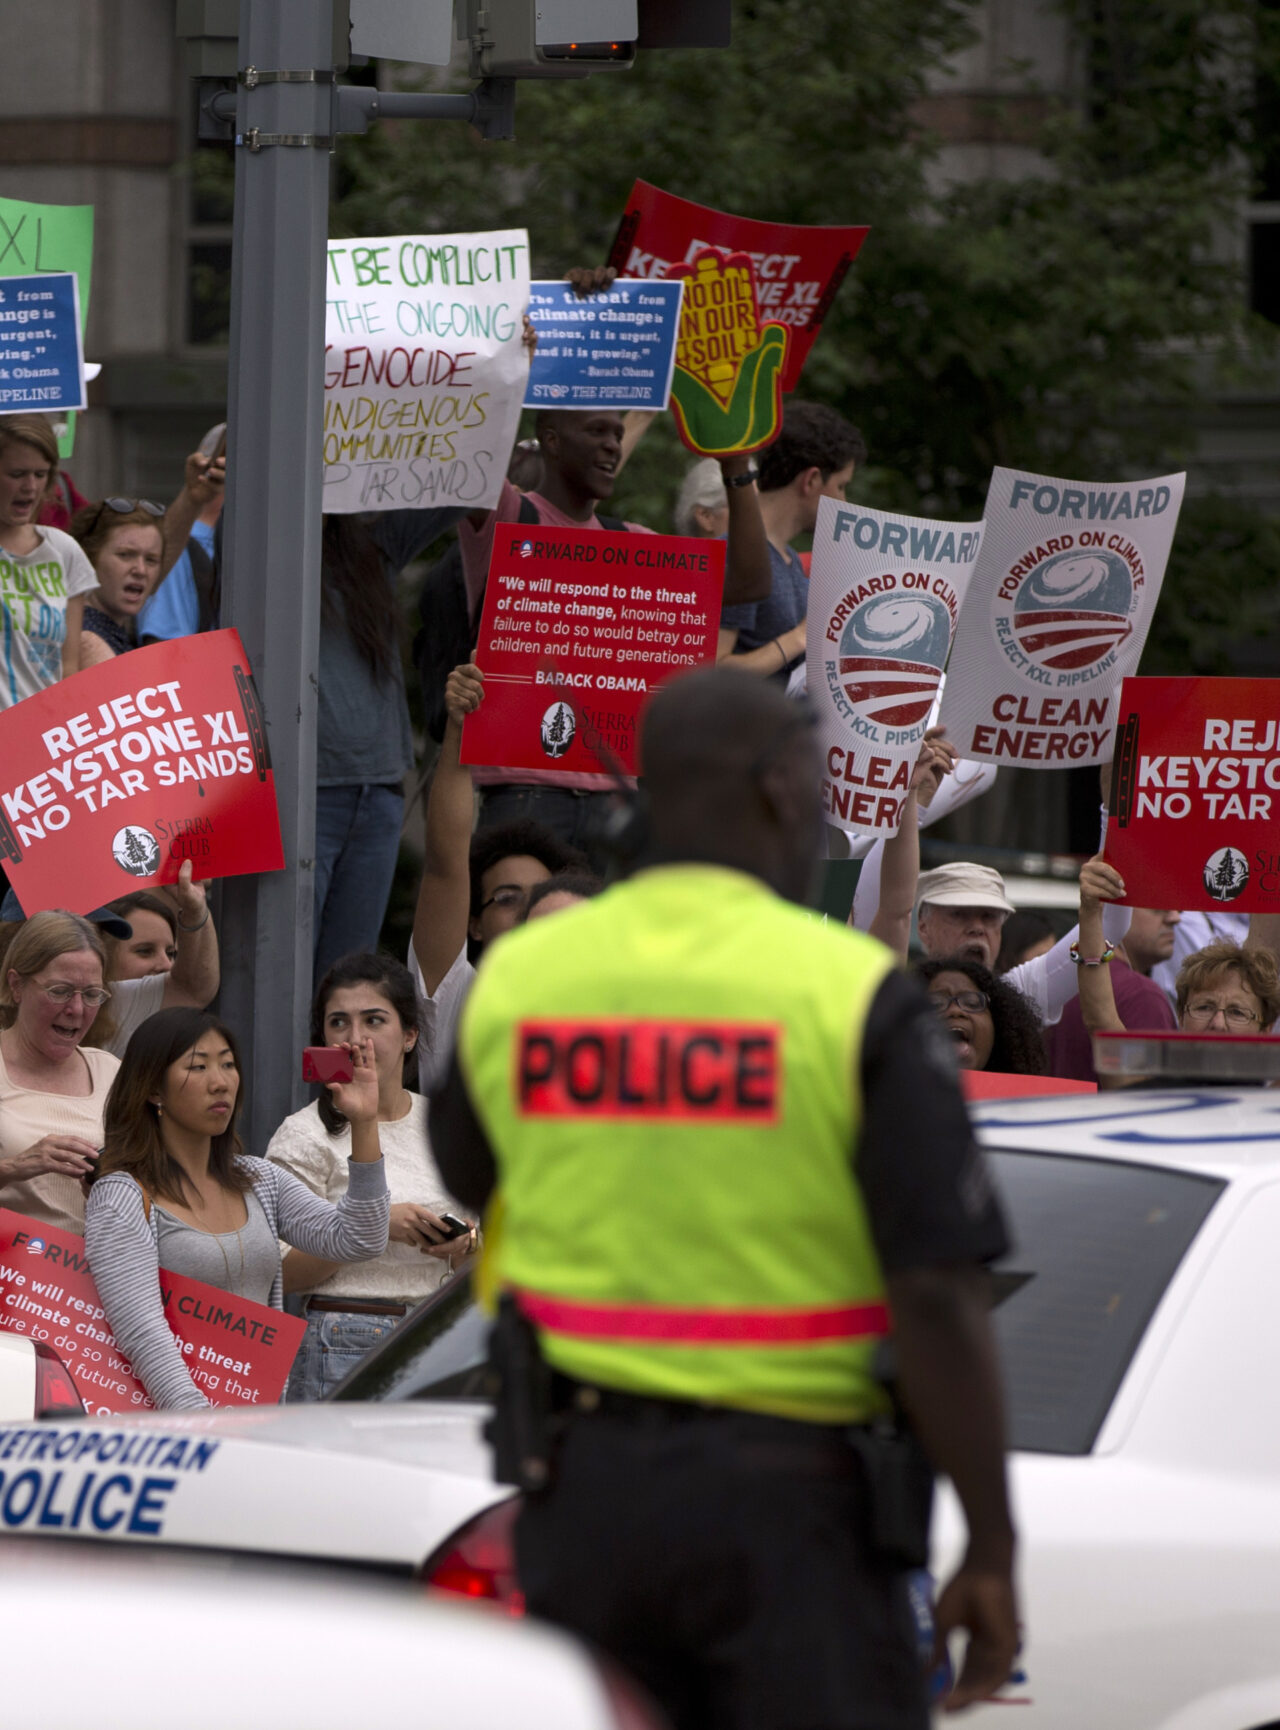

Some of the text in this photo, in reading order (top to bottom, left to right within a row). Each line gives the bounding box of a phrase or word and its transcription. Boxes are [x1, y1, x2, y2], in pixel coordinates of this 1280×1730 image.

[352, 242, 526, 287] BE COMPLICIT
[17, 291, 54, 301] from
[683, 277, 746, 309] NO OIL
[43, 310, 55, 319] is
[326, 301, 516, 342] THE ONGOING
[529, 309, 653, 325] climate change
[705, 303, 752, 335] OUR
[0, 329, 57, 342] urgent,
[693, 333, 742, 365] SOIL
[533, 385, 569, 396] STOP
[356, 450, 493, 505] TAR SANDS
[1009, 480, 1171, 520] FORWARD
[510, 540, 709, 572] FORWARD ON CLIMATE
[998, 532, 1146, 601] FORWARD ON CLIMATE
[498, 576, 696, 604] “We will respond to the threat
[497, 598, 706, 625] of climate change, knowing that
[826, 573, 930, 642] FORWARD ON
[994, 616, 1119, 687] REJECT KXL PIPELINE
[535, 671, 647, 692] BARACK OBAMA
[41, 681, 184, 760] REJECT
[992, 694, 1110, 726] CLEAN
[851, 718, 879, 743] KXL
[970, 725, 1111, 760] ENERGY
[1, 711, 249, 822] KEYSTONE XL
[16, 747, 253, 848] NO TAR SANDS
[1136, 792, 1272, 820] NO TAR
[522, 1036, 773, 1107] POLICE
[5, 1293, 71, 1327] climate
[31, 1282, 64, 1307] will
[177, 1296, 278, 1346] CLIMATE
[198, 1343, 253, 1377] threat
[224, 1379, 261, 1404] that
